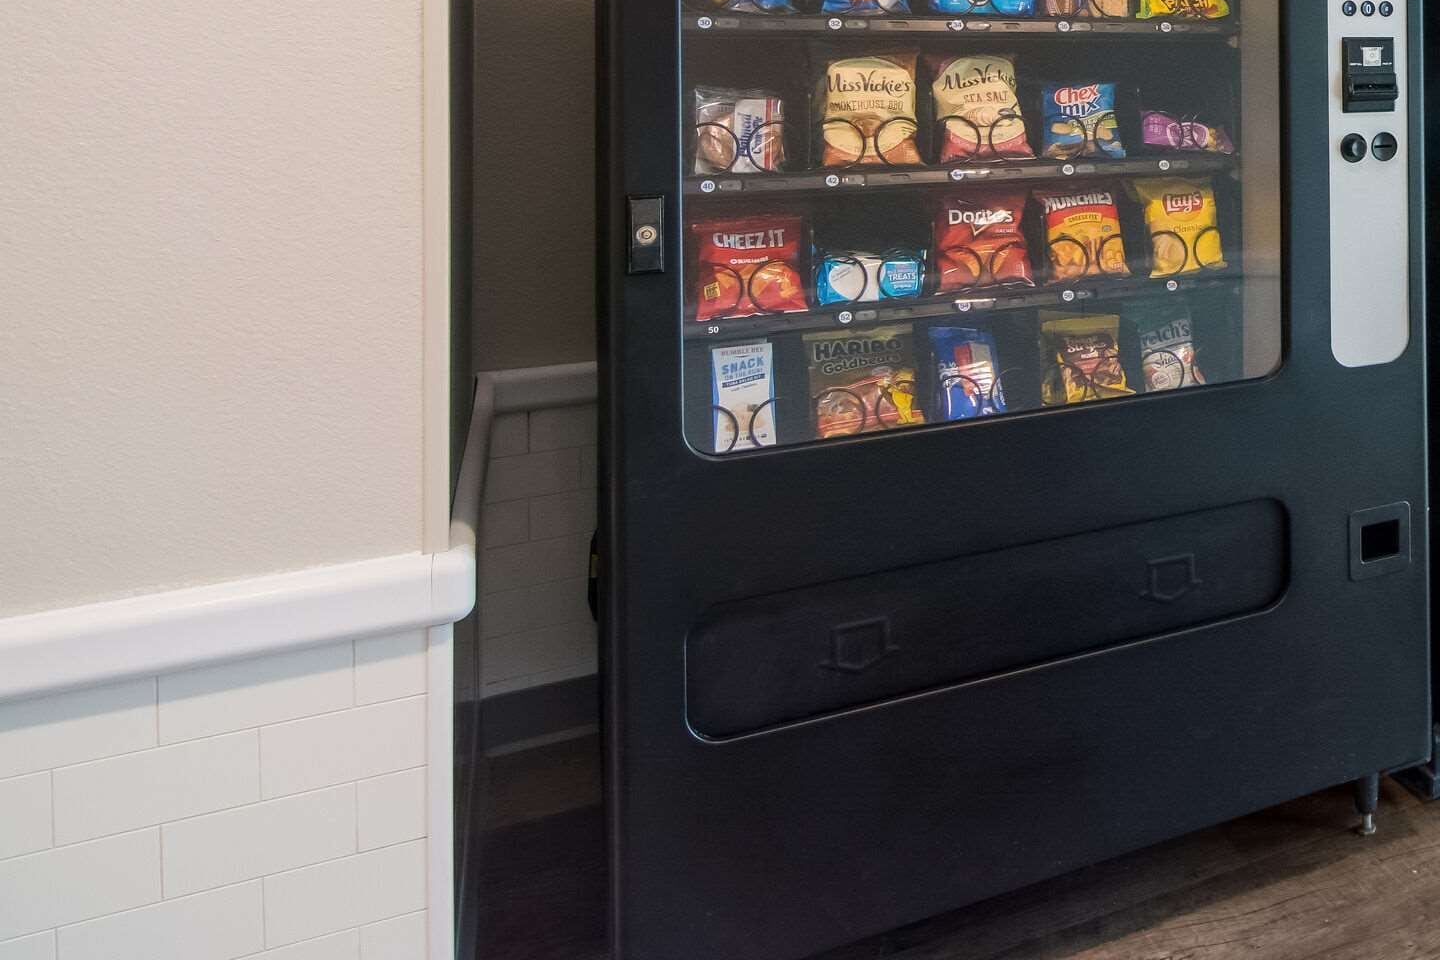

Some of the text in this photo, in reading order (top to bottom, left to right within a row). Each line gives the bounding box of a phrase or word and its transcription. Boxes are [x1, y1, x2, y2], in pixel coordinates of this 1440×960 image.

[1365, 4, 1371, 14] 0
[827, 70, 911, 96] Miss Vickie's
[942, 72, 979, 91] Miss
[964, 90, 1008, 103] SEA SALT
[1055, 83, 1099, 106] Chex
[1061, 96, 1101, 118] mix
[1042, 192, 1114, 214] MUNCHIES
[1166, 193, 1200, 213] Lay's
[948, 209, 1013, 225] Doritos
[888, 272, 916, 281] TREATS
[708, 326, 719, 334] 50
[721, 356, 765, 375] SNACK
